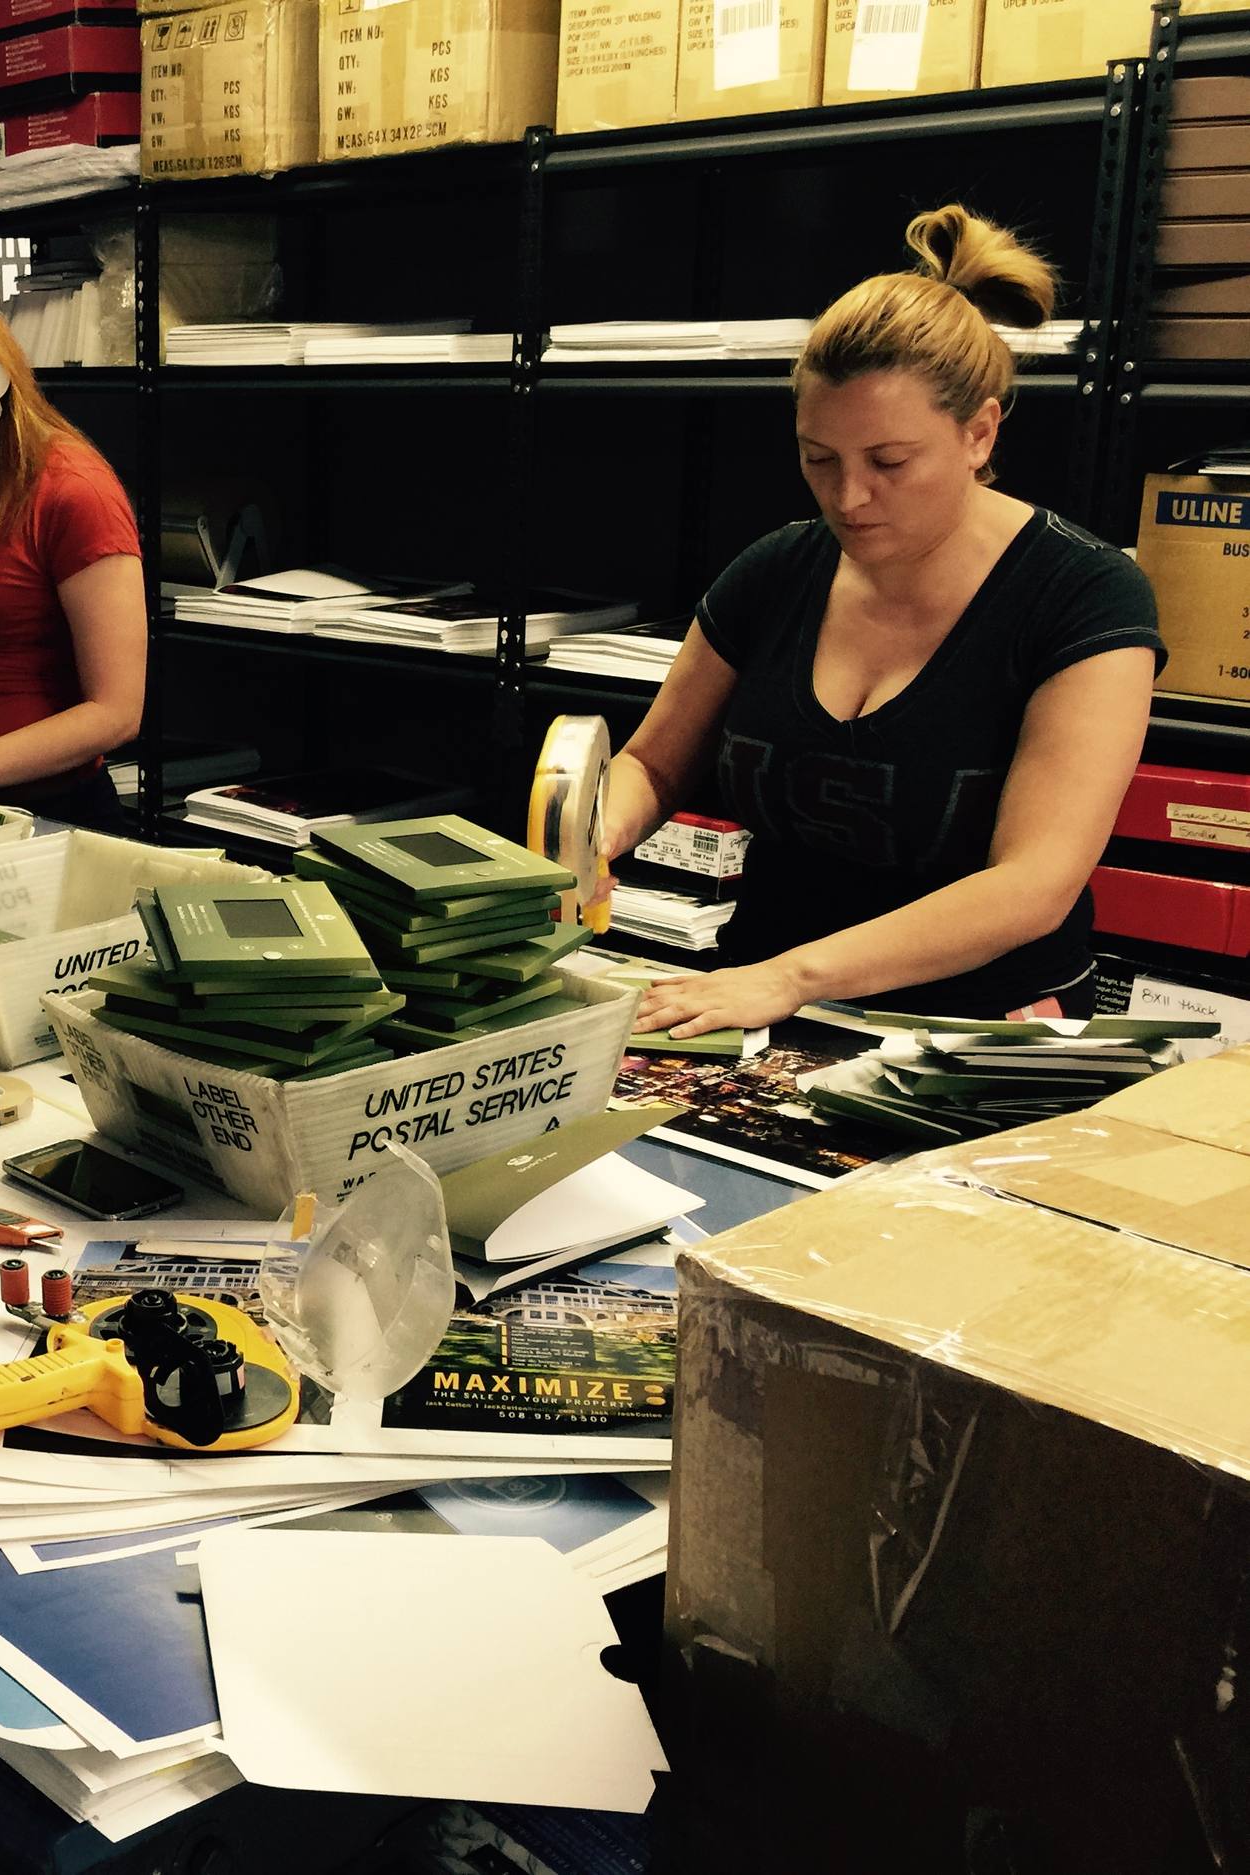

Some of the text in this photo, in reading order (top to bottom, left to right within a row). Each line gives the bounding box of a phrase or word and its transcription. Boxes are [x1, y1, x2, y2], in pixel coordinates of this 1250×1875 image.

[568, 17, 612, 31] DESCRIPTION
[628, 11, 662, 22] MOLDING
[835, 9, 852, 20] SIZE
[339, 25, 384, 45] ITEM NO:
[688, 30, 703, 39] SIZE
[431, 40, 451, 56] PCS
[687, 42, 706, 51] UPC#
[339, 54, 360, 71] QTY:
[566, 56, 580, 66] SIZE
[151, 65, 168, 79] ITEM
[430, 67, 450, 83] KGS
[223, 81, 240, 95] PCS
[338, 80, 356, 95] NW:
[428, 94, 448, 110] KGS
[223, 105, 240, 119] KGS
[337, 106, 355, 121] GW:
[224, 129, 241, 142] KGS
[1171, 499, 1244, 524] ULINE
[1218, 664, 1250, 680] 1-80
[54, 939, 140, 980] UNITED
[1178, 998, 1218, 1017] thick
[365, 1044, 567, 1118] UNITED STATES
[183, 1076, 250, 1111] LABEL
[192, 1100, 260, 1135] OTHER
[348, 1071, 578, 1161] POSTAL SERVICE
[210, 1124, 253, 1152] END
[434, 1371, 633, 1401] MAXIMIZE
[433, 1391, 634, 1409] THE SALE OF YOUR PROPERTY
